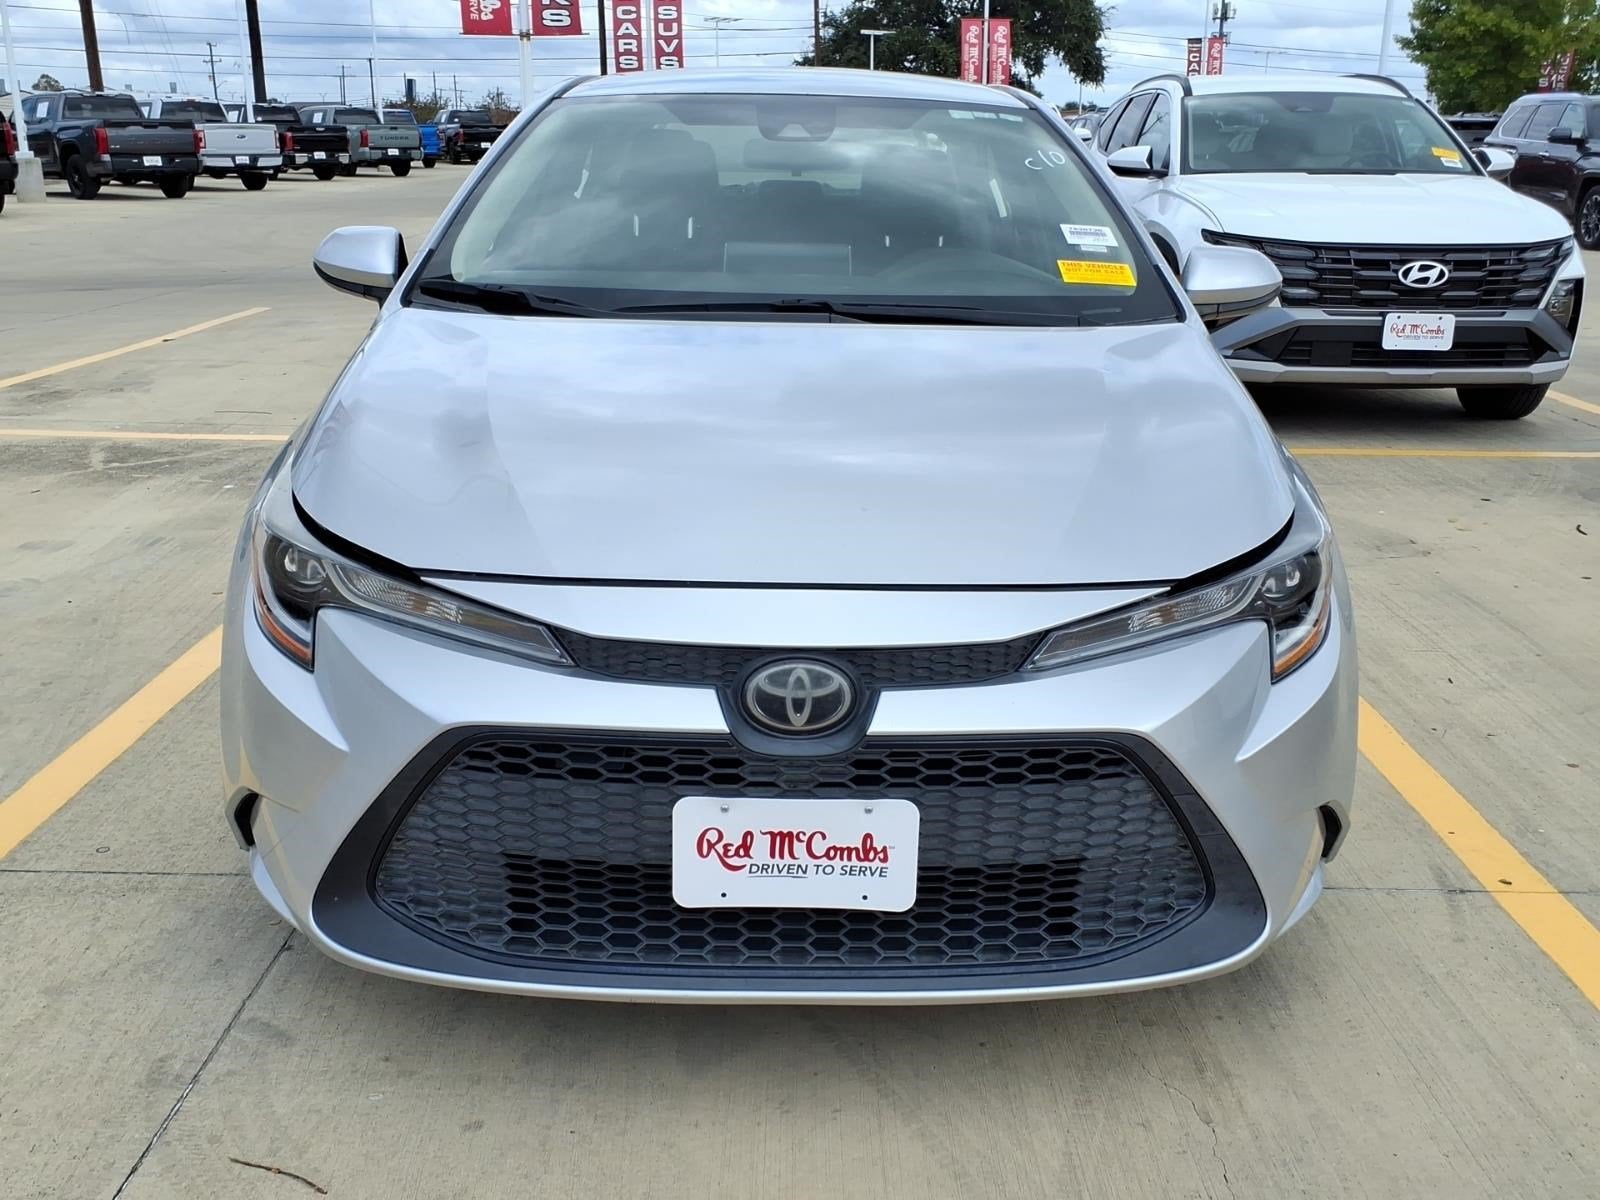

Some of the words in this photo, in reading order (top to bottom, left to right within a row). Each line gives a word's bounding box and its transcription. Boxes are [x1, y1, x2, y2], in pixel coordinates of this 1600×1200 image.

[616, 5, 639, 69] CARS
[657, 5, 680, 69] SUVS
[966, 25, 980, 43] Red
[994, 25, 1008, 43] Red
[1086, 263, 1125, 271] VEHICLE
[1390, 322, 1407, 338] Red
[1408, 323, 1445, 336] McCombs
[696, 826, 755, 872] Red
[759, 829, 889, 864] McCombs
[748, 863, 809, 875] DRIVEN
[813, 864, 835, 876] TO
[839, 865, 889, 878] SERVE
